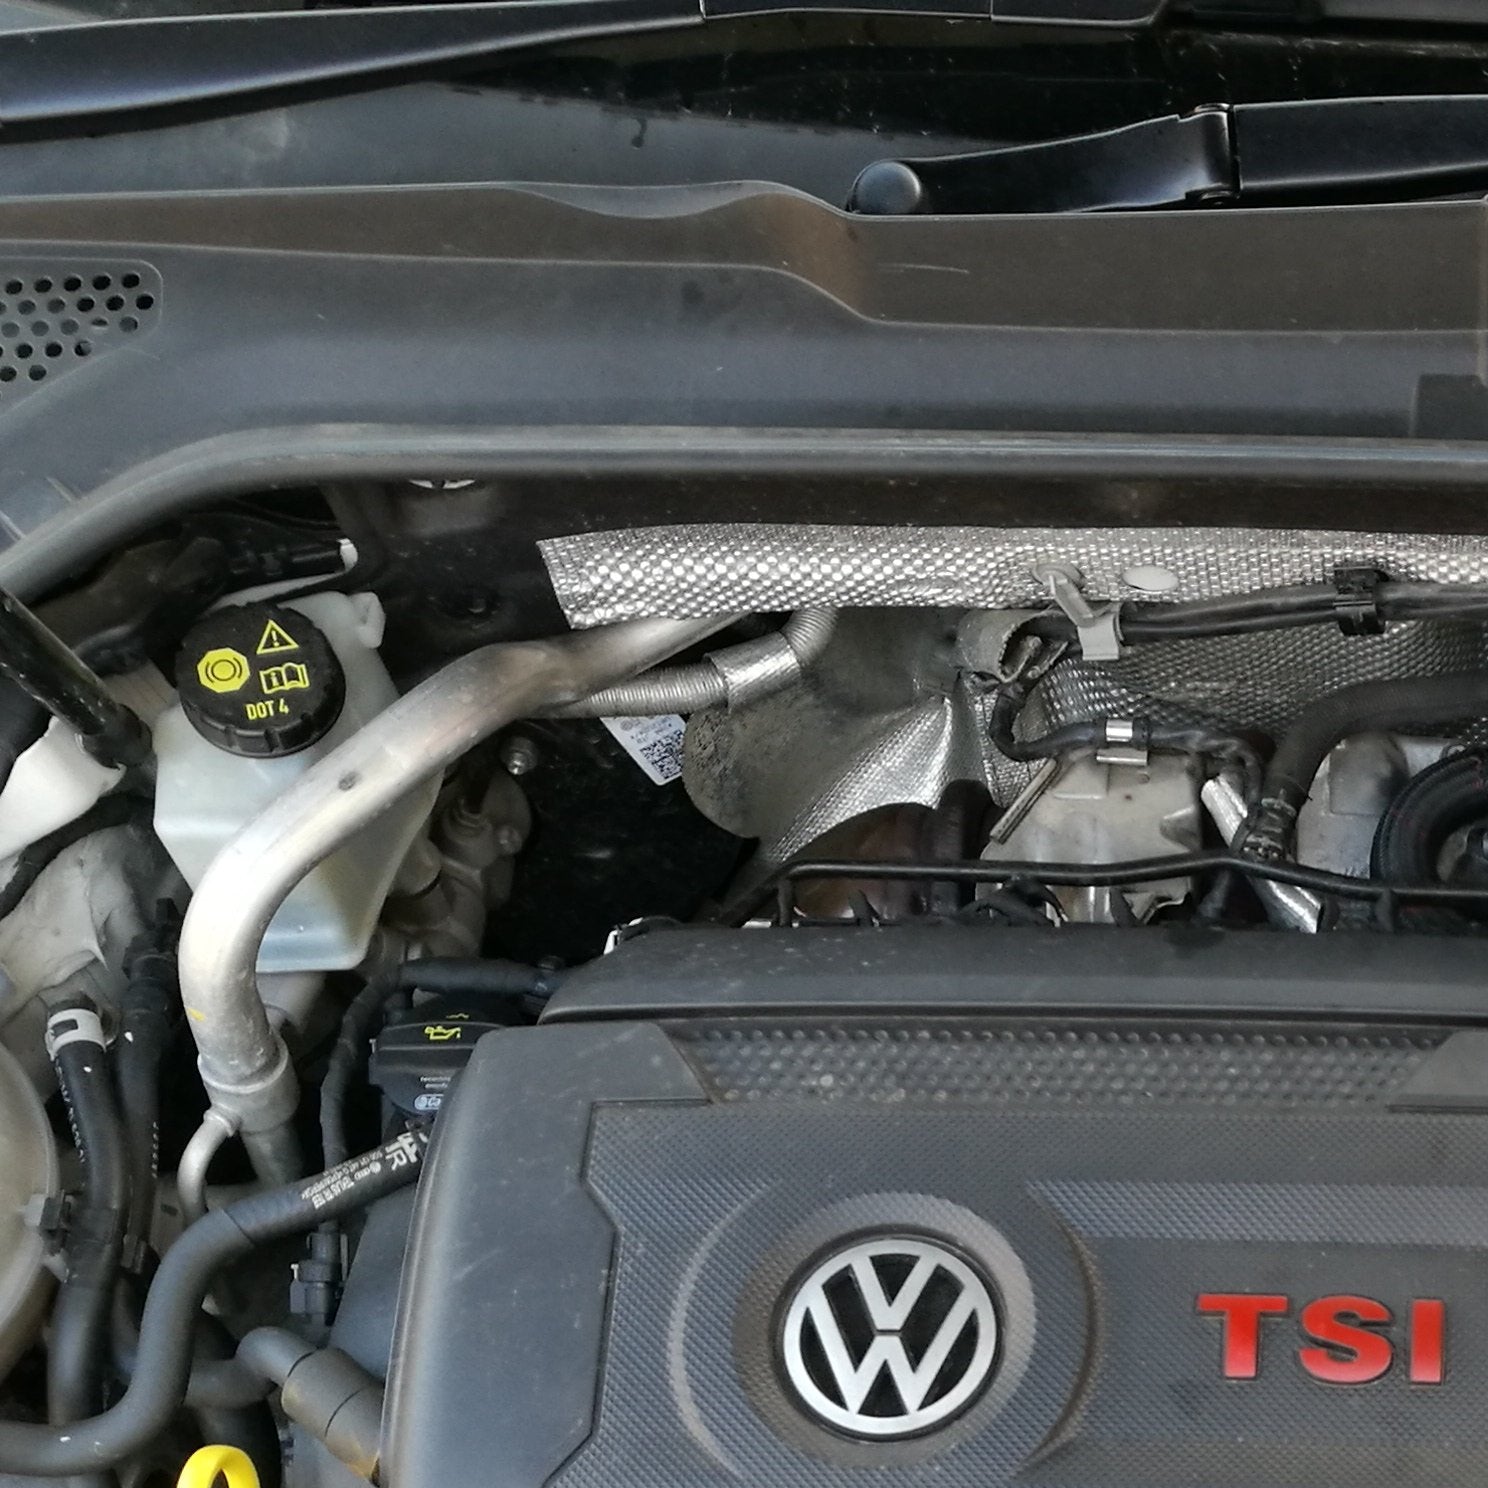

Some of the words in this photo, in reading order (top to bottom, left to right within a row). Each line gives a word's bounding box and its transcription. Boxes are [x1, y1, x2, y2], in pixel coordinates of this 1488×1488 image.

[246, 700, 275, 720] DOT
[279, 699, 289, 714] 4
[1196, 1293, 1448, 1385] TSI
